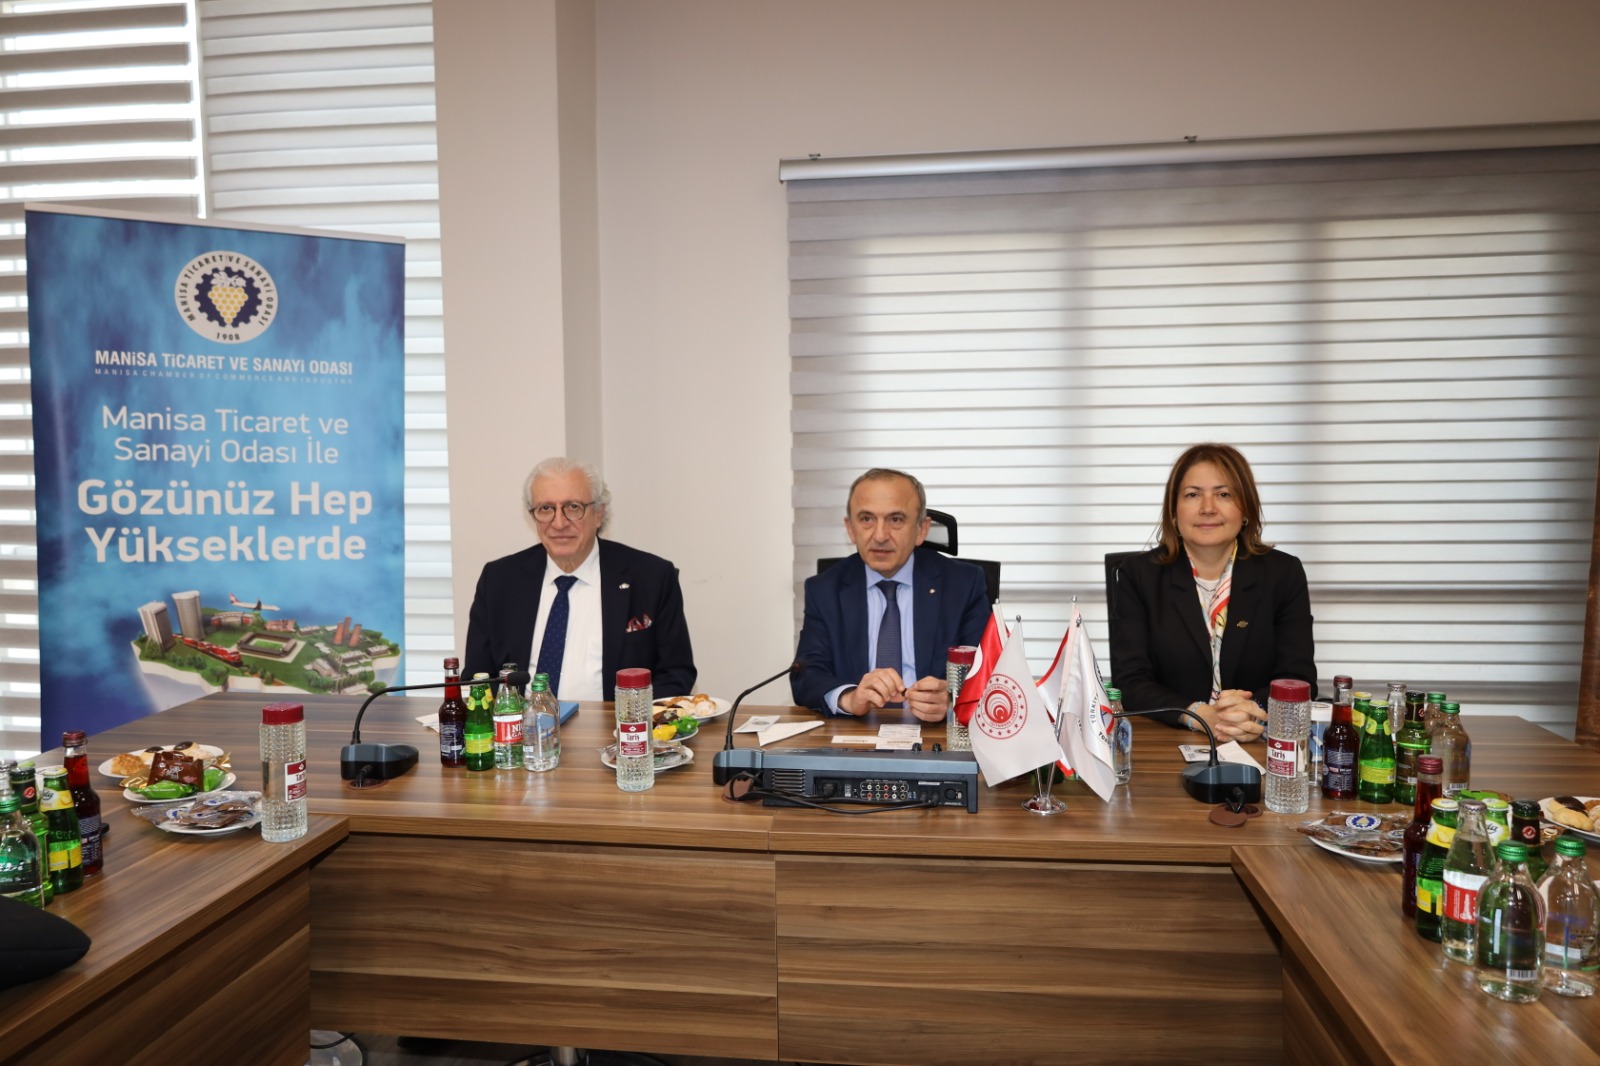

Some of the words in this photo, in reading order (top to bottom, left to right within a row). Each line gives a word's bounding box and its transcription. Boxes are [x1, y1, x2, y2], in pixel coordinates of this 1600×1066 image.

[228, 255, 241, 265] VE
[258, 297, 275, 327] ODASI
[229, 356, 249, 371] VE
[309, 360, 353, 375] ODASI
[102, 405, 206, 432] Manisa
[215, 409, 309, 434] Ticaret
[318, 416, 349, 435] ve
[114, 437, 211, 468] Sanayi
[221, 439, 297, 464] Odası
[306, 436, 339, 464] İle
[77, 479, 275, 516] Gözünüz
[290, 481, 373, 523] Hep
[84, 526, 367, 563] Yükseklerde
